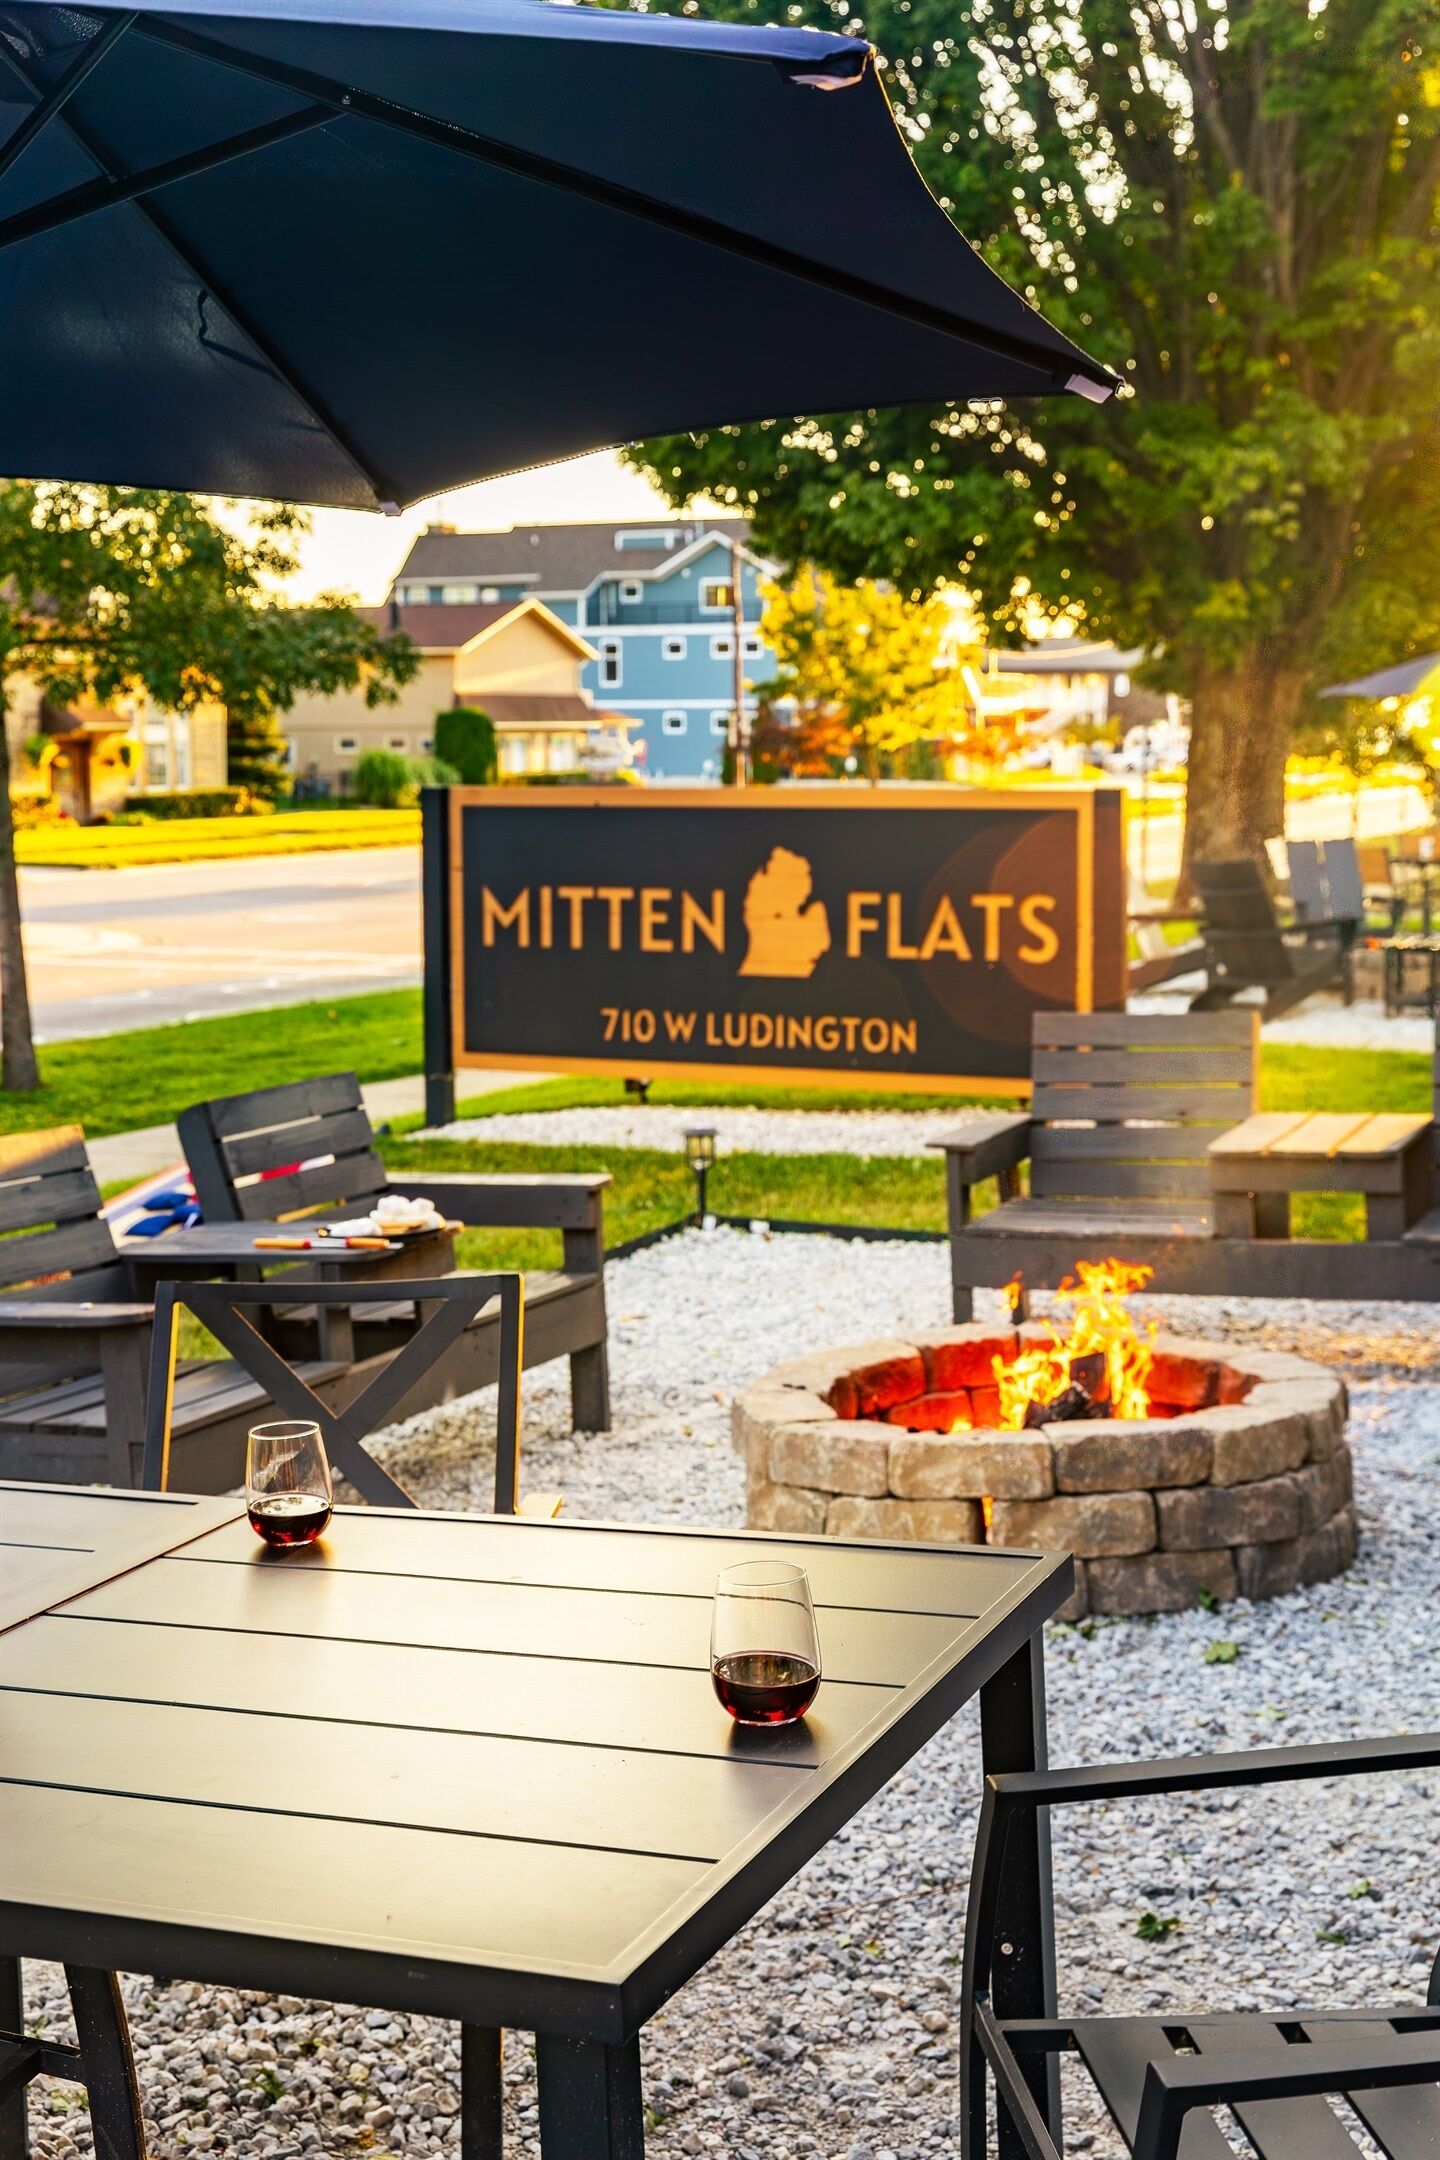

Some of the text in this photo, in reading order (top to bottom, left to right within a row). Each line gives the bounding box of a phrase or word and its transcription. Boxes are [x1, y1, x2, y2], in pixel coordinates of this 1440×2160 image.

[481, 885, 1060, 965] MITTEN FLATS
[600, 1007, 918, 1055] 710 W LUDINGTON
